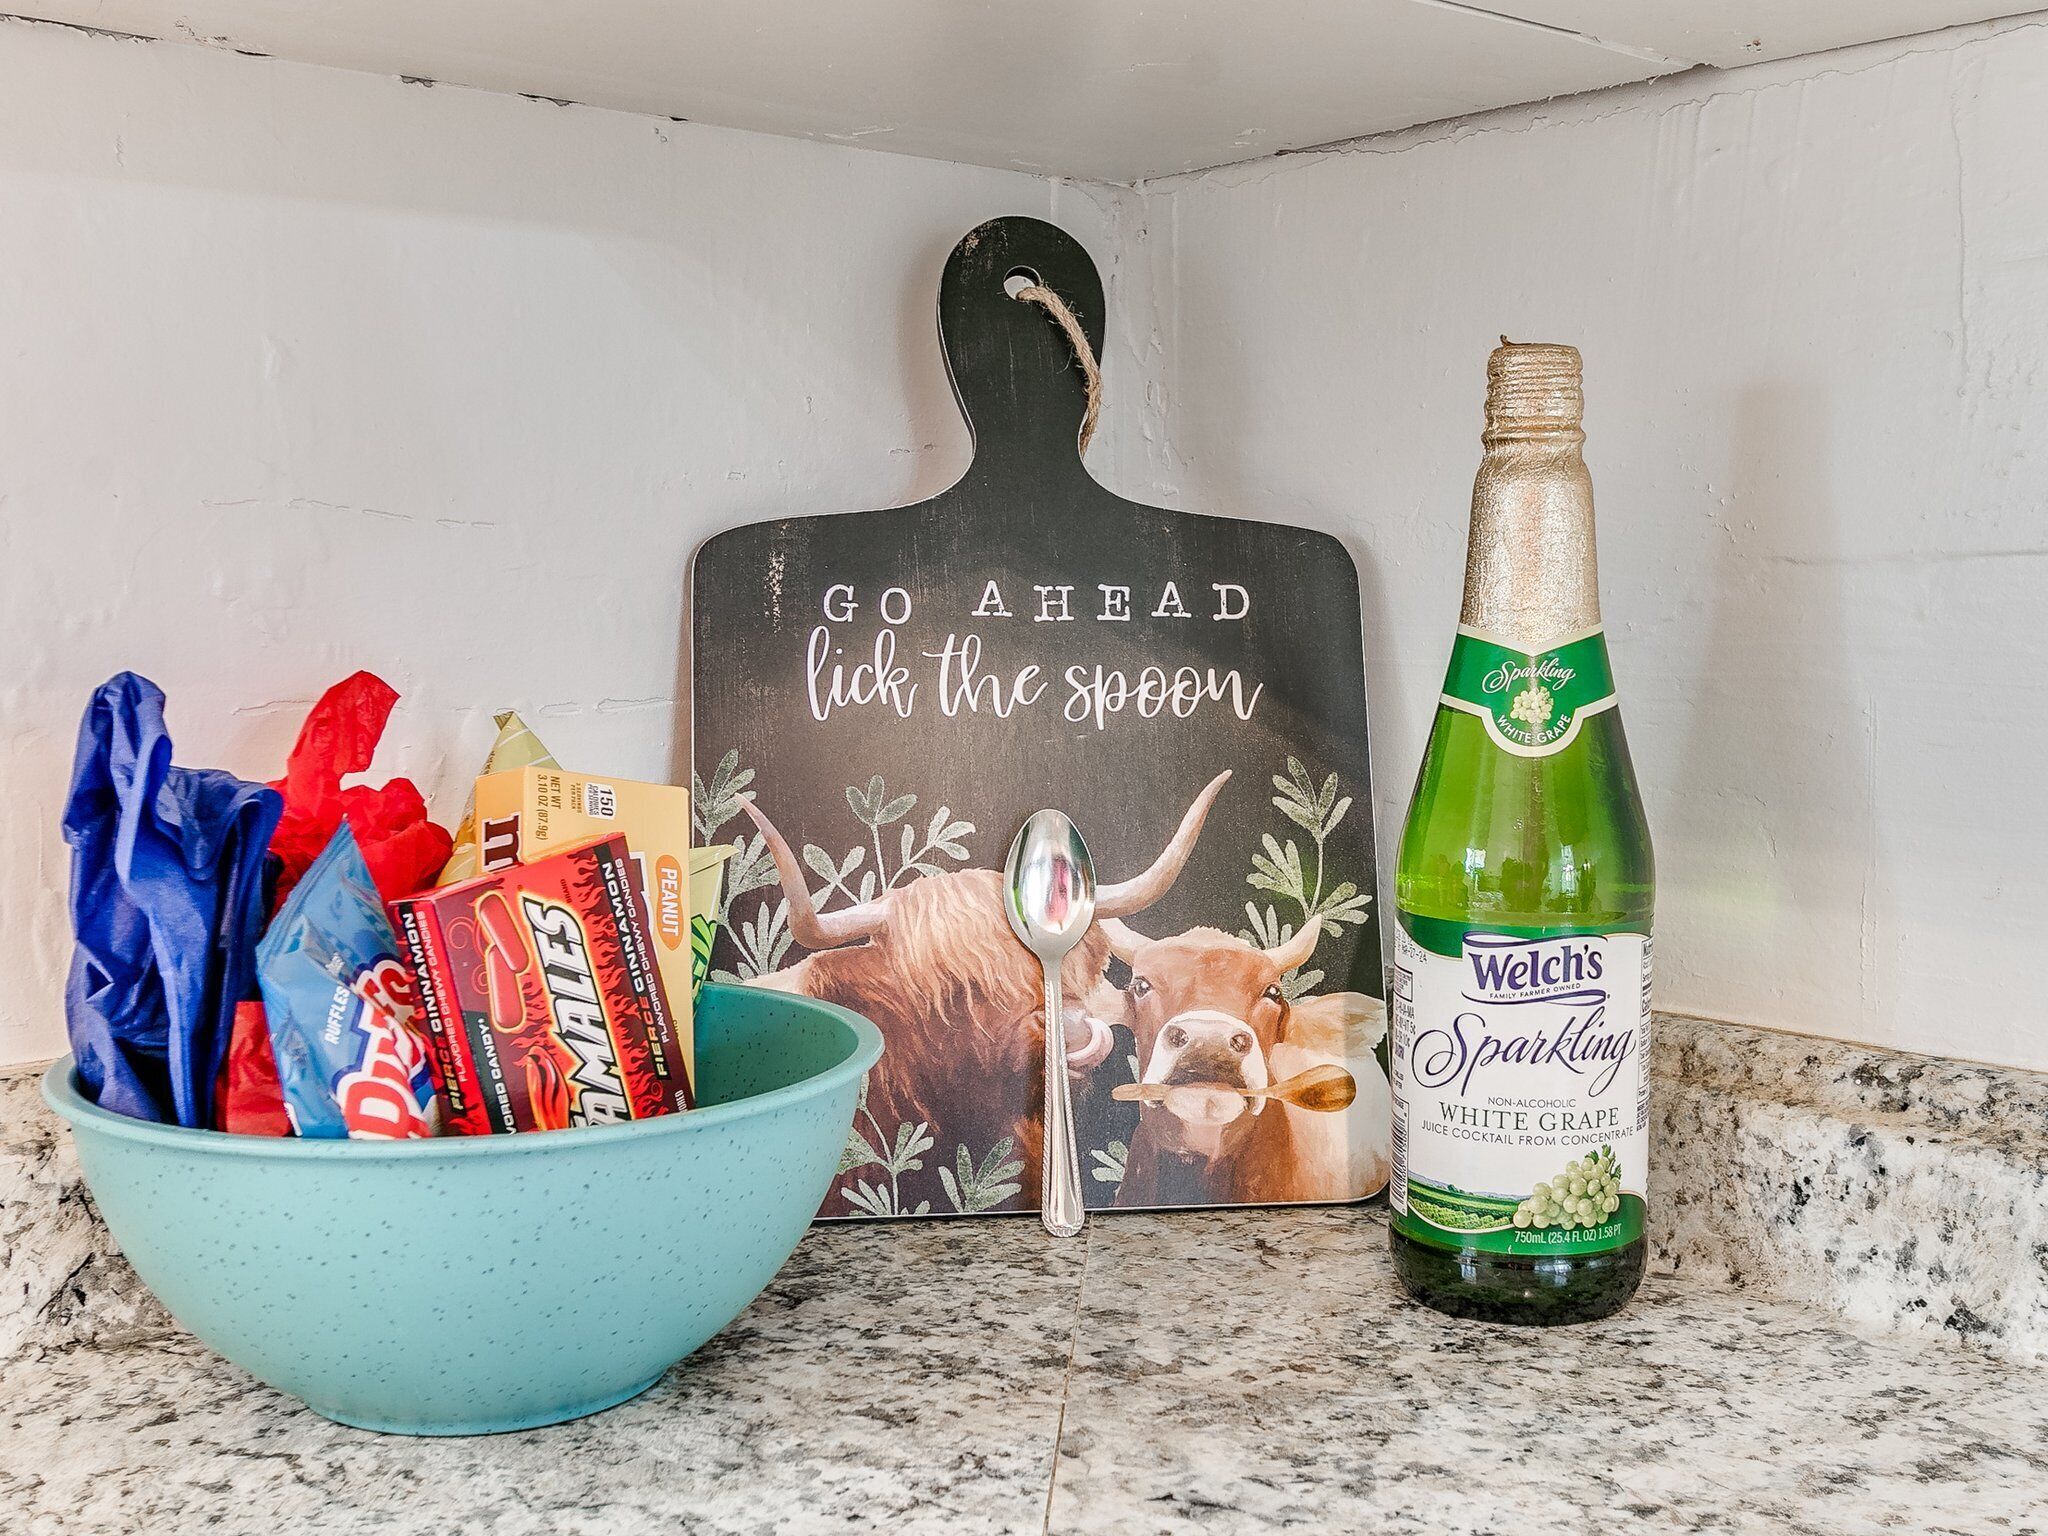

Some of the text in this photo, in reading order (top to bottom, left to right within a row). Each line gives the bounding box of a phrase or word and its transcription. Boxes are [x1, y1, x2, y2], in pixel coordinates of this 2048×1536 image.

[823, 580, 1252, 625] GO AHEAD
[806, 626, 1263, 731] lick the spoon
[1482, 657, 1576, 694] Sparkling
[1497, 713, 1572, 744] WHITE GRAPE
[535, 774, 549, 840] 3.10 OZ (87.9g)
[550, 775, 562, 810] NET WT
[600, 788, 614, 817] 150
[660, 866, 680, 938] PEANUT
[402, 912, 443, 1033] CINNAMON
[602, 861, 668, 1077] FIERCE CINNAMON
[614, 857, 670, 1044] FLAVORED CHEWY CANDIES
[1468, 944, 1603, 992] Welch's
[324, 985, 350, 1046] RUFFLES
[416, 910, 469, 1082] FLAVORED CHEWY CANDIES
[522, 897, 628, 1129] AMALES
[1489, 982, 1582, 999] FAMILY FARMER OWNED
[1411, 1006, 1636, 1098] Sparkling
[493, 1081, 518, 1136] VORED
[1438, 1101, 1529, 1131] WHITE
[1538, 1107, 1620, 1132] GRAPE
[1487, 1097, 1577, 1109] NON-ALCOHOLIC
[1421, 1119, 1634, 1147] JUICE COCKTAIL FROM CONCENTRATE
[1514, 1223, 1623, 1244] 750mL (25.4 FL OZ) 1.58 PT
